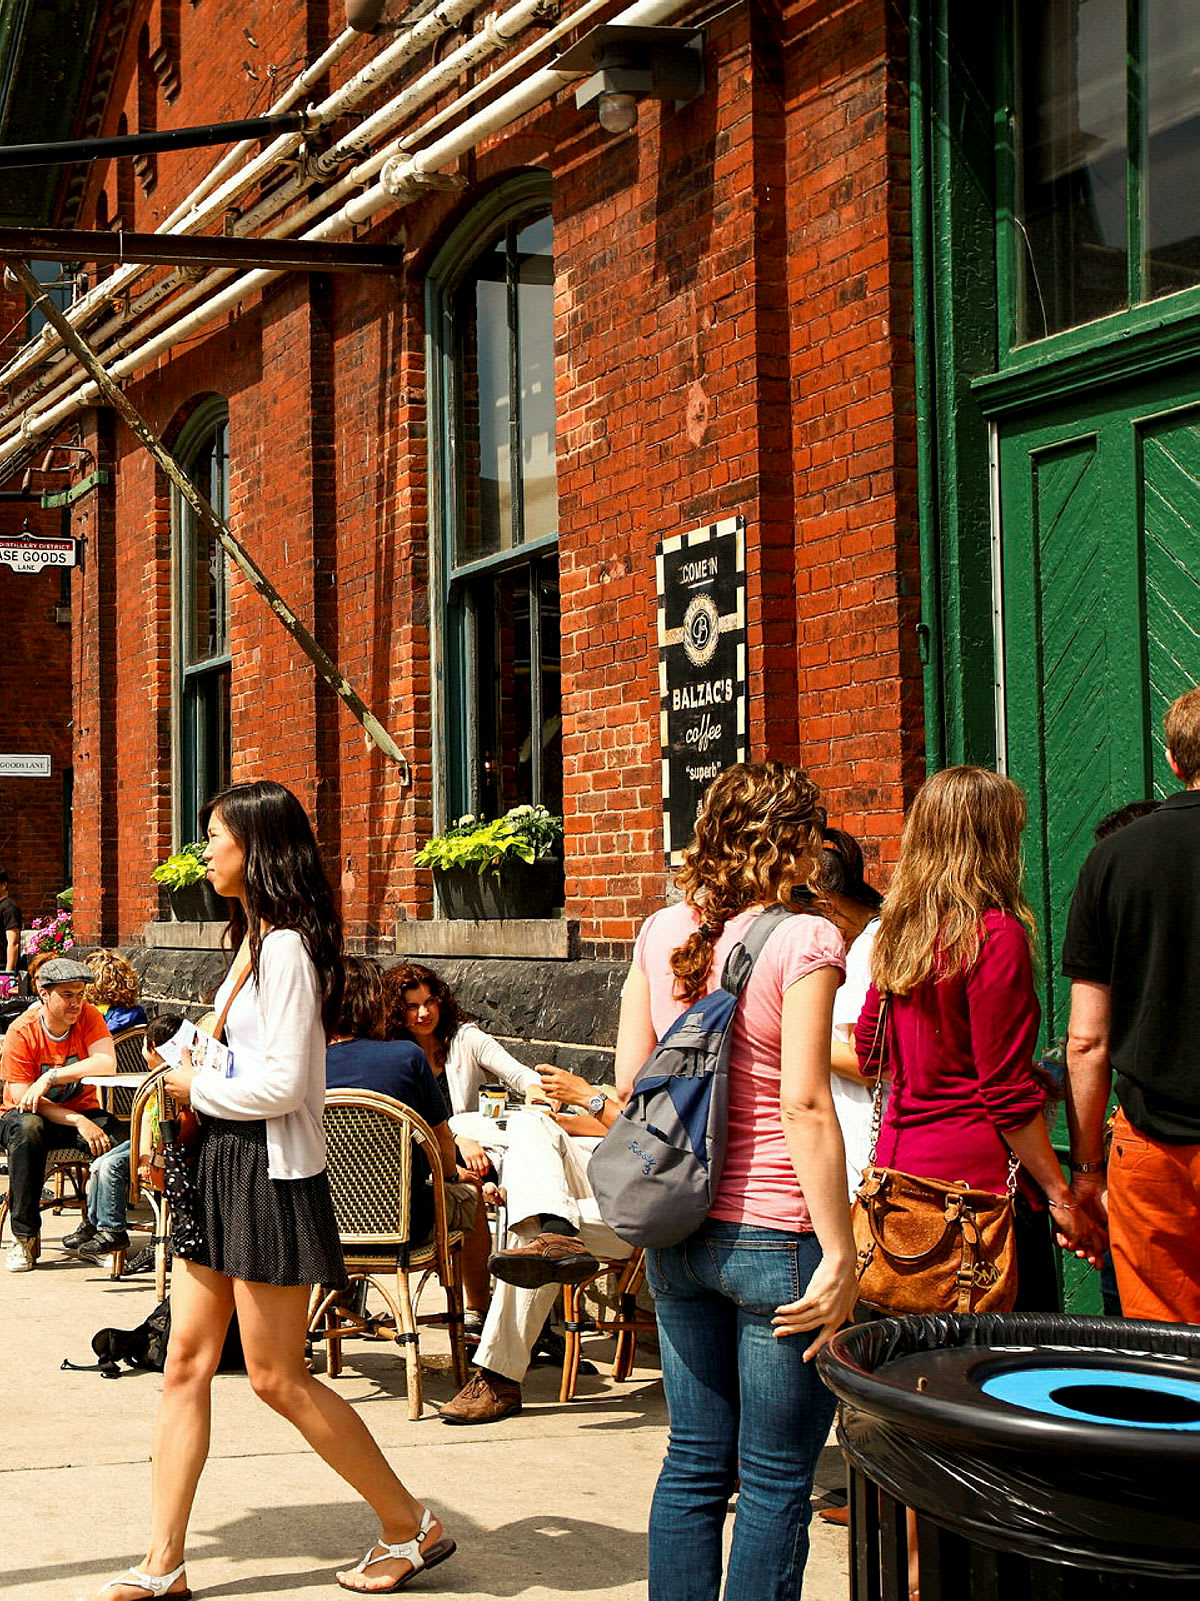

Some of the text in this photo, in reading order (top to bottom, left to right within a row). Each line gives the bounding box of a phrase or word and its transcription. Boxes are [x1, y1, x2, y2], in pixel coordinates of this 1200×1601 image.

[22, 551, 67, 564] GOODS
[682, 559, 708, 582] COME
[672, 678, 733, 711] BALZAC'S
[685, 713, 722, 752] coffee
